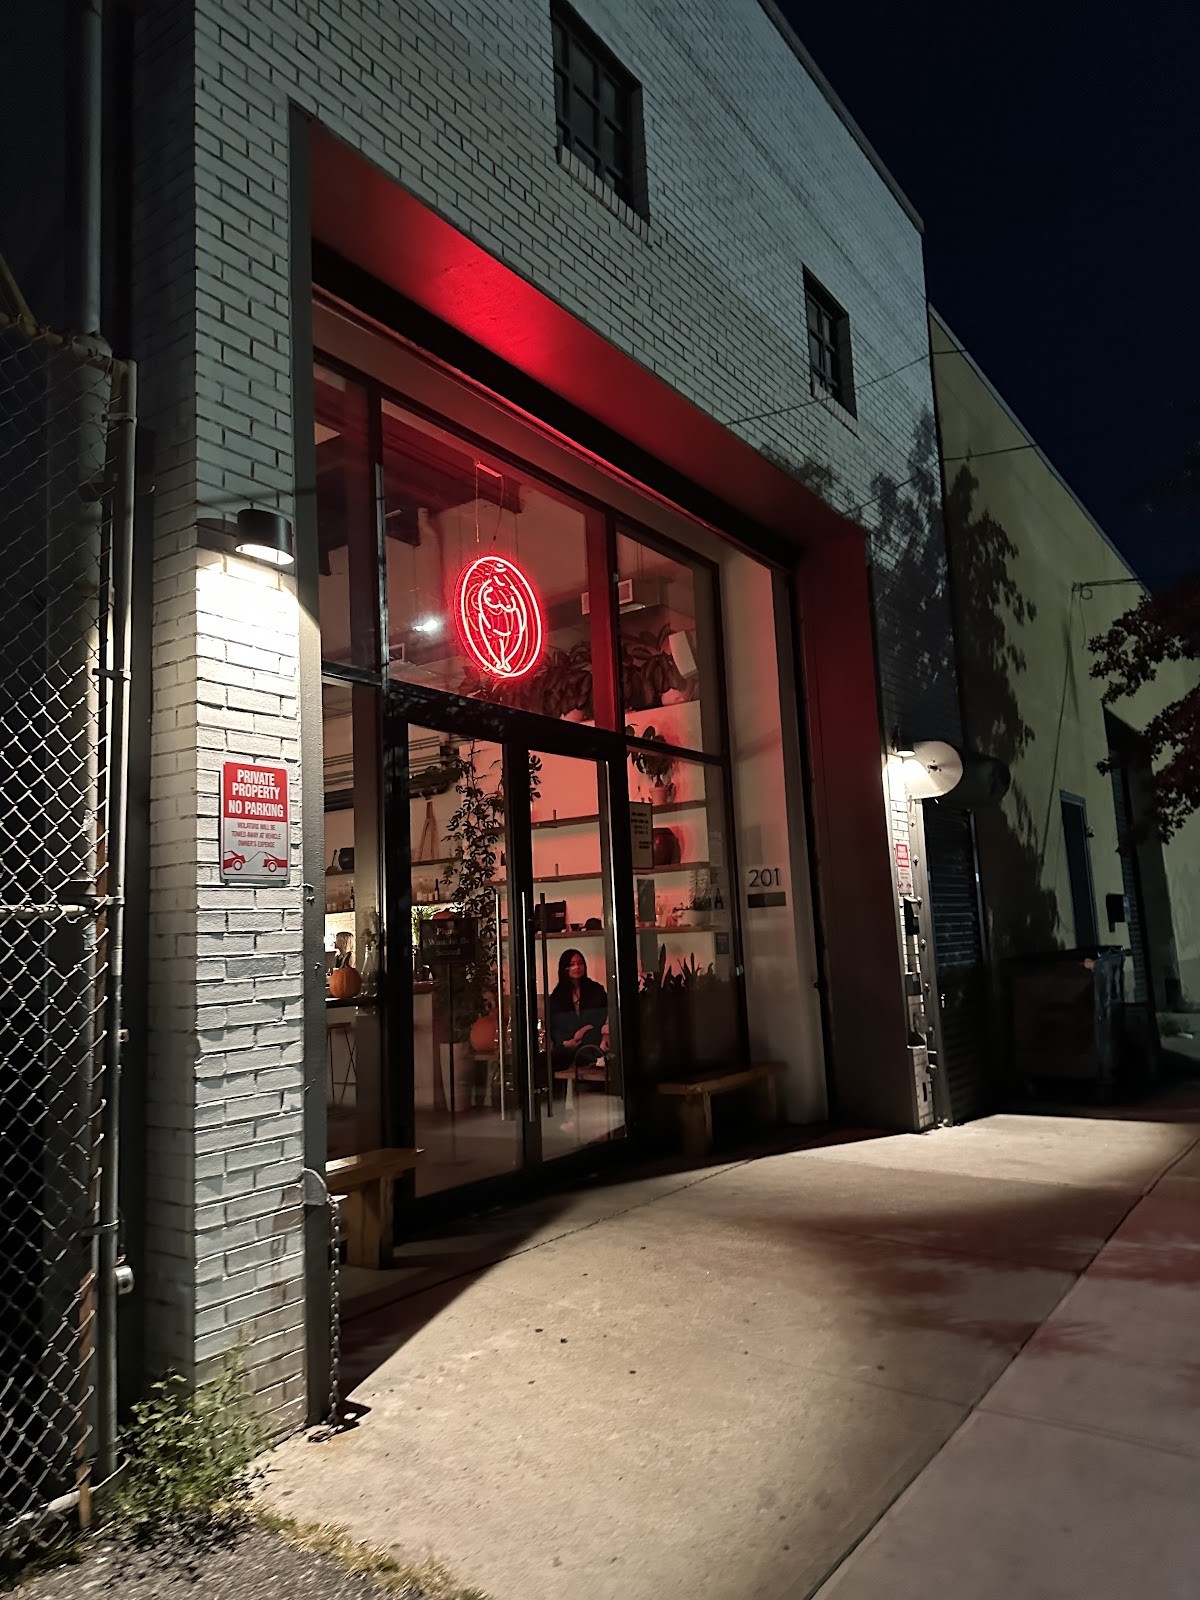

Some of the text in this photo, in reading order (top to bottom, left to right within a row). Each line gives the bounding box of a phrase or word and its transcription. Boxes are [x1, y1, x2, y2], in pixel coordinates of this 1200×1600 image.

[237, 769, 275, 786] PRIVATE
[232, 782, 280, 800] PROPERTY
[228, 799, 284, 818] NO PARKING
[748, 868, 780, 887] 201
